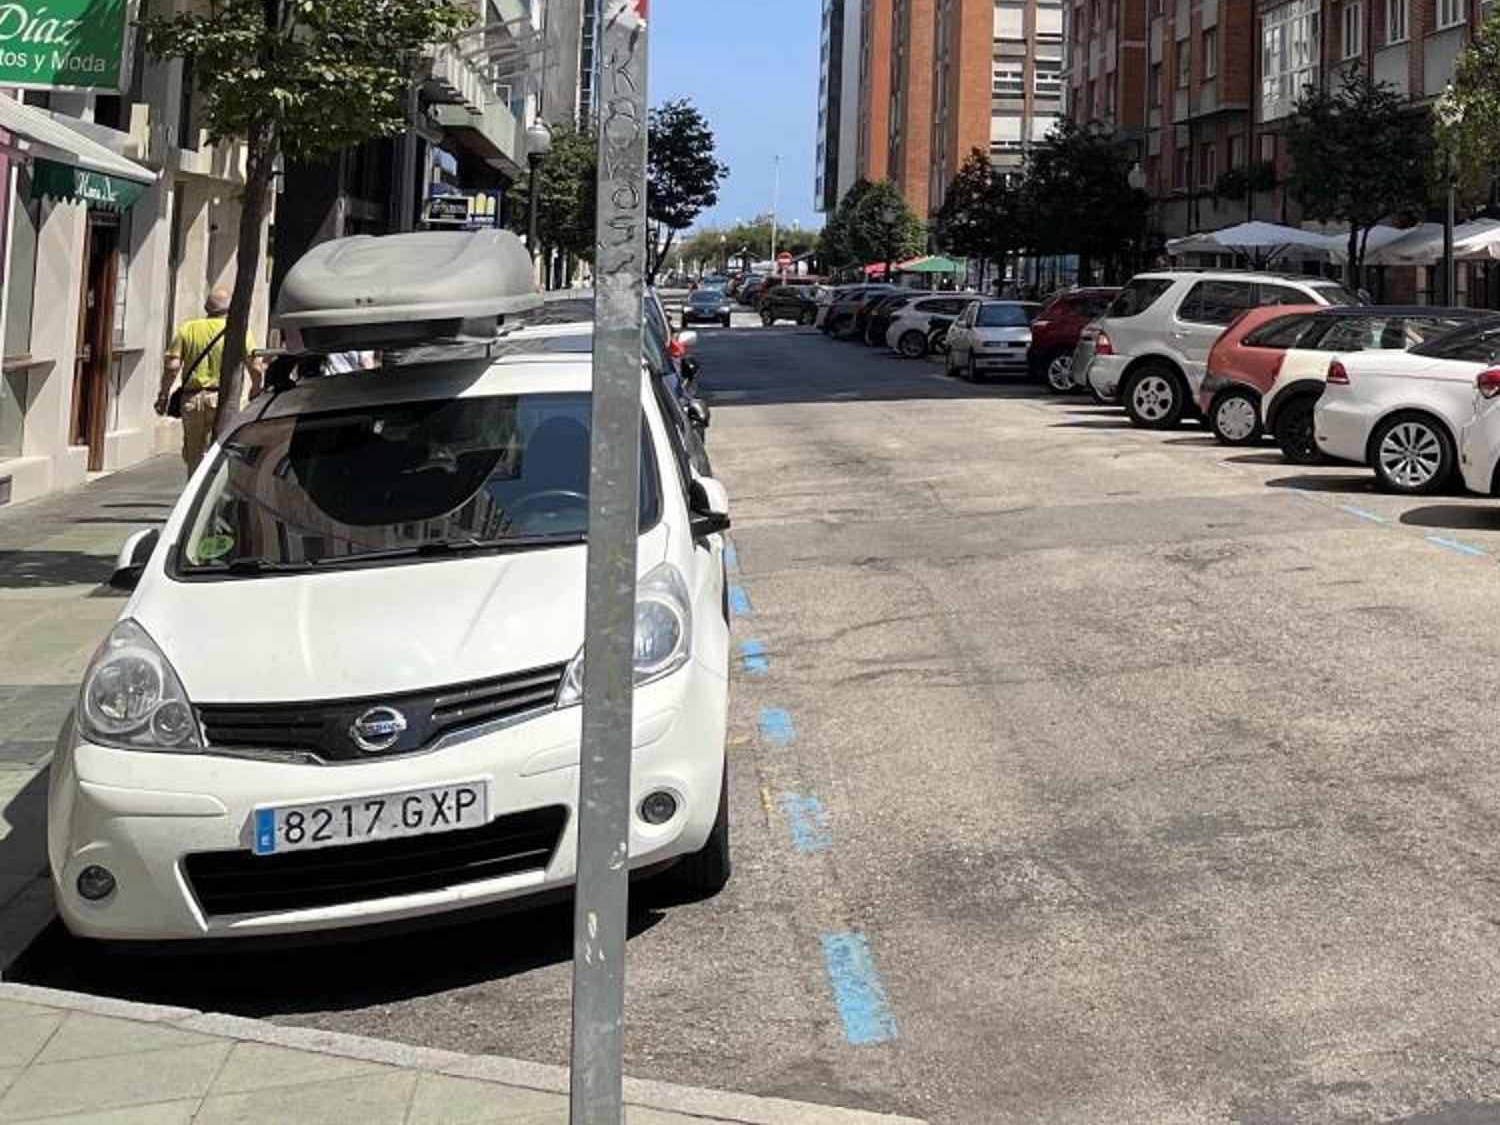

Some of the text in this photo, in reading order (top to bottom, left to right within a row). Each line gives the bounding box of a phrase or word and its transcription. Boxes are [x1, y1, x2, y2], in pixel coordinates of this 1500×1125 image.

[0, 3, 83, 46] Díaz
[34, 53, 46, 74] y
[51, 50, 107, 72] Moda
[284, 788, 477, 844] 8217 GXP
